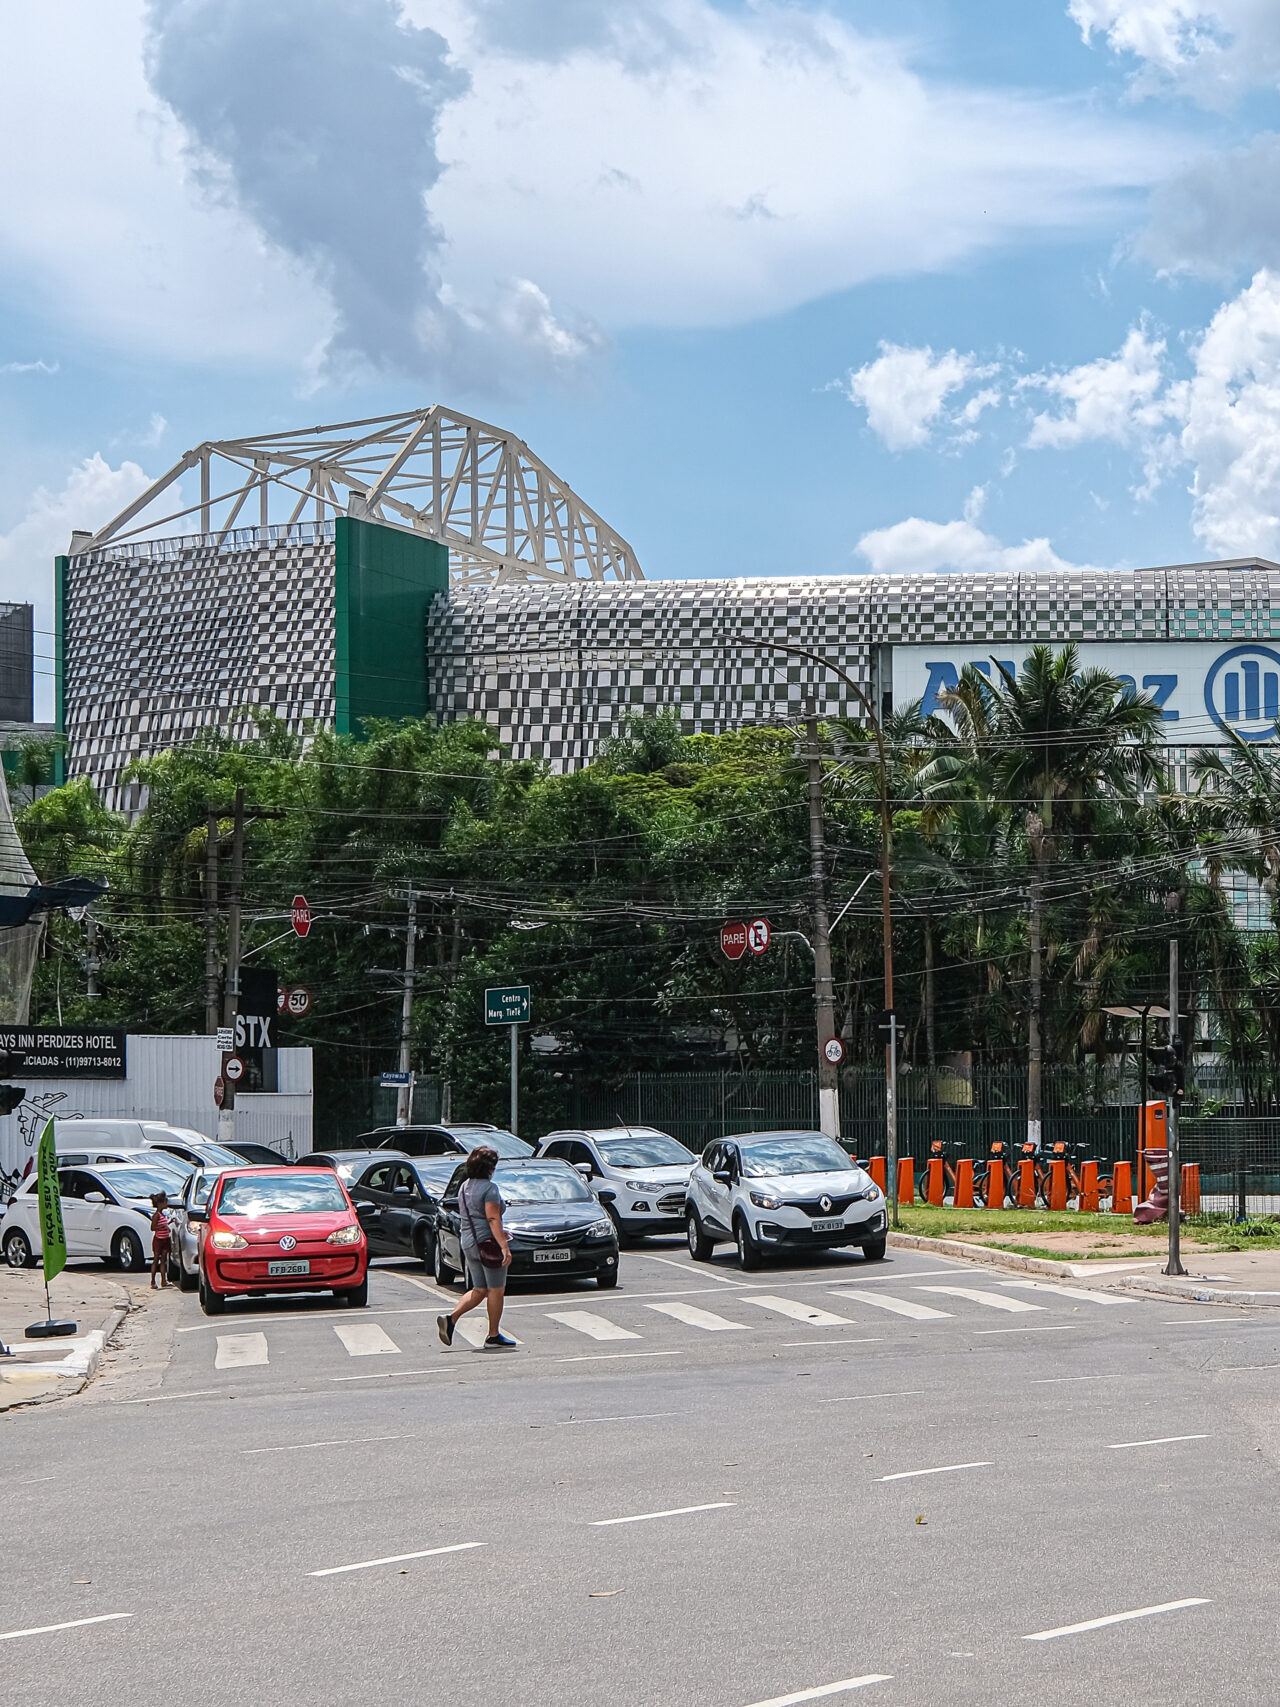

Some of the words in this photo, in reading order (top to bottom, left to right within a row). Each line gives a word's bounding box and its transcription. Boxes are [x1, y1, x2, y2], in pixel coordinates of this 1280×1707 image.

[292, 909, 310, 923] PARE
[723, 932, 745, 946] PARE
[290, 993, 308, 1006] 50
[501, 994, 521, 1004] Centro
[488, 1008, 504, 1020] Marg.
[235, 1014, 272, 1048] STX
[18, 1034, 35, 1048] INN
[37, 1035, 84, 1049] PERDIZES
[85, 1035, 117, 1049] HOTEL
[49, 1151, 57, 1183] AQUI
[44, 1185, 52, 1209] SEU
[53, 1185, 62, 1224] COVID
[45, 1213, 56, 1246] FAÇA
[57, 1226, 65, 1244] DE
